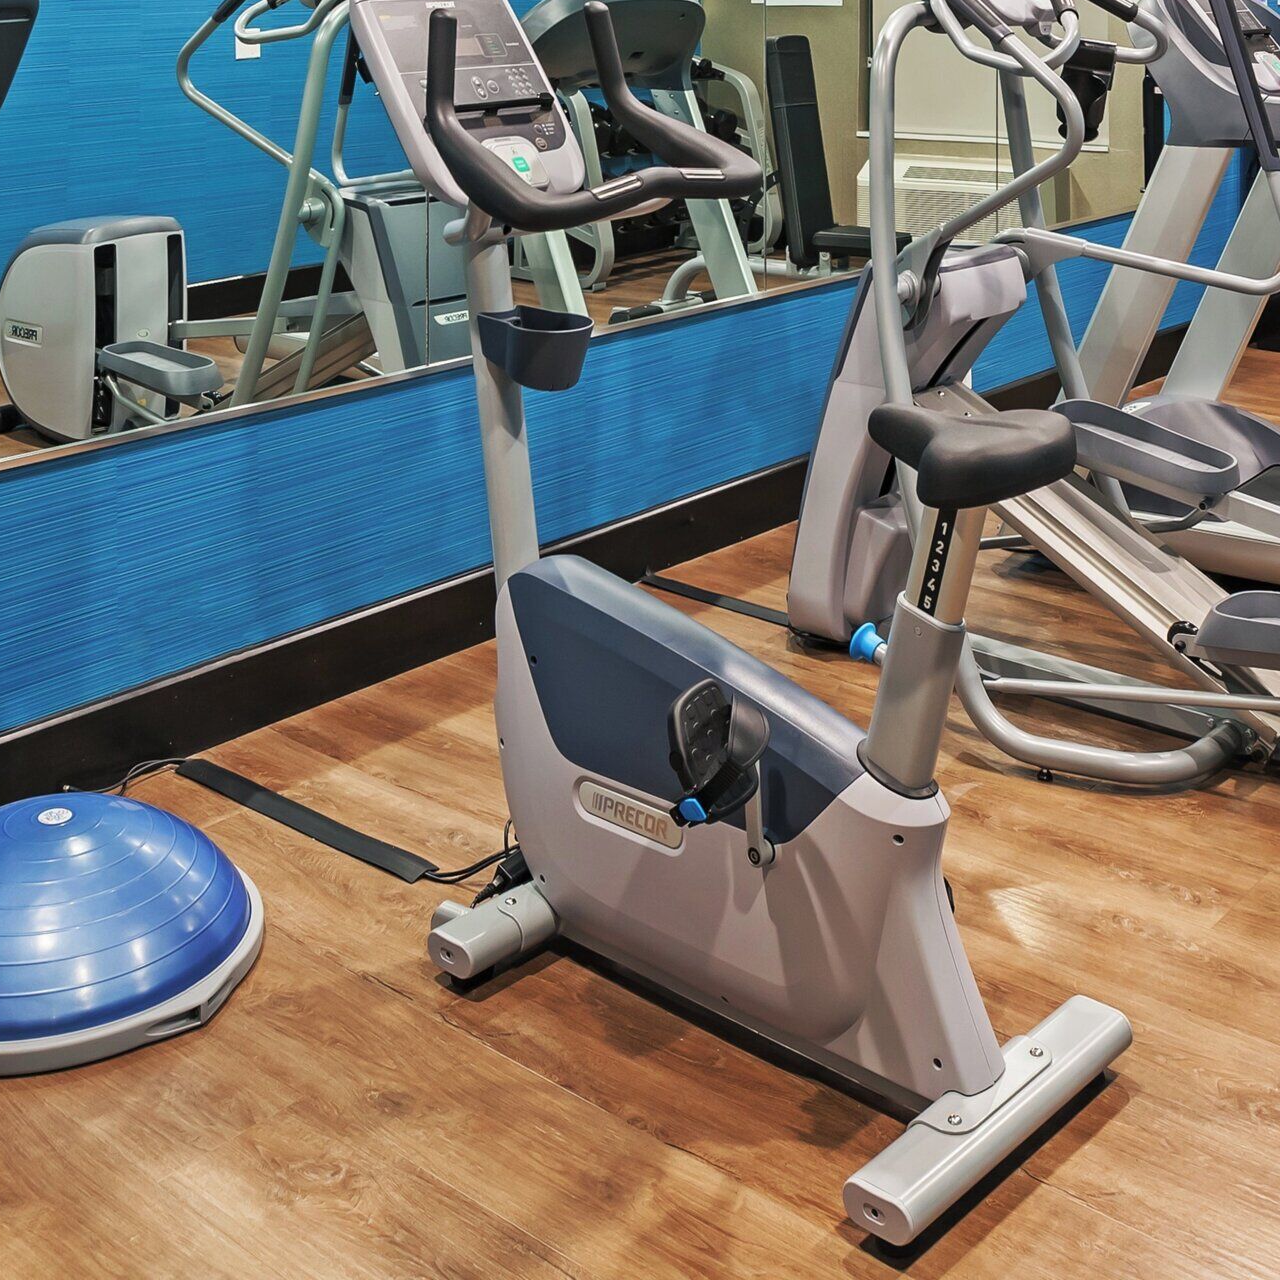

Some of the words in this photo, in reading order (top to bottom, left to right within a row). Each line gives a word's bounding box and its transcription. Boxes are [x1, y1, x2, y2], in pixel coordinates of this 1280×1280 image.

[941, 522, 948, 536] 1
[935, 540, 945, 555] 2
[931, 559, 941, 573] 3
[927, 578, 936, 592] 4
[923, 595, 932, 609] 5
[603, 795, 668, 840] PRECOR
